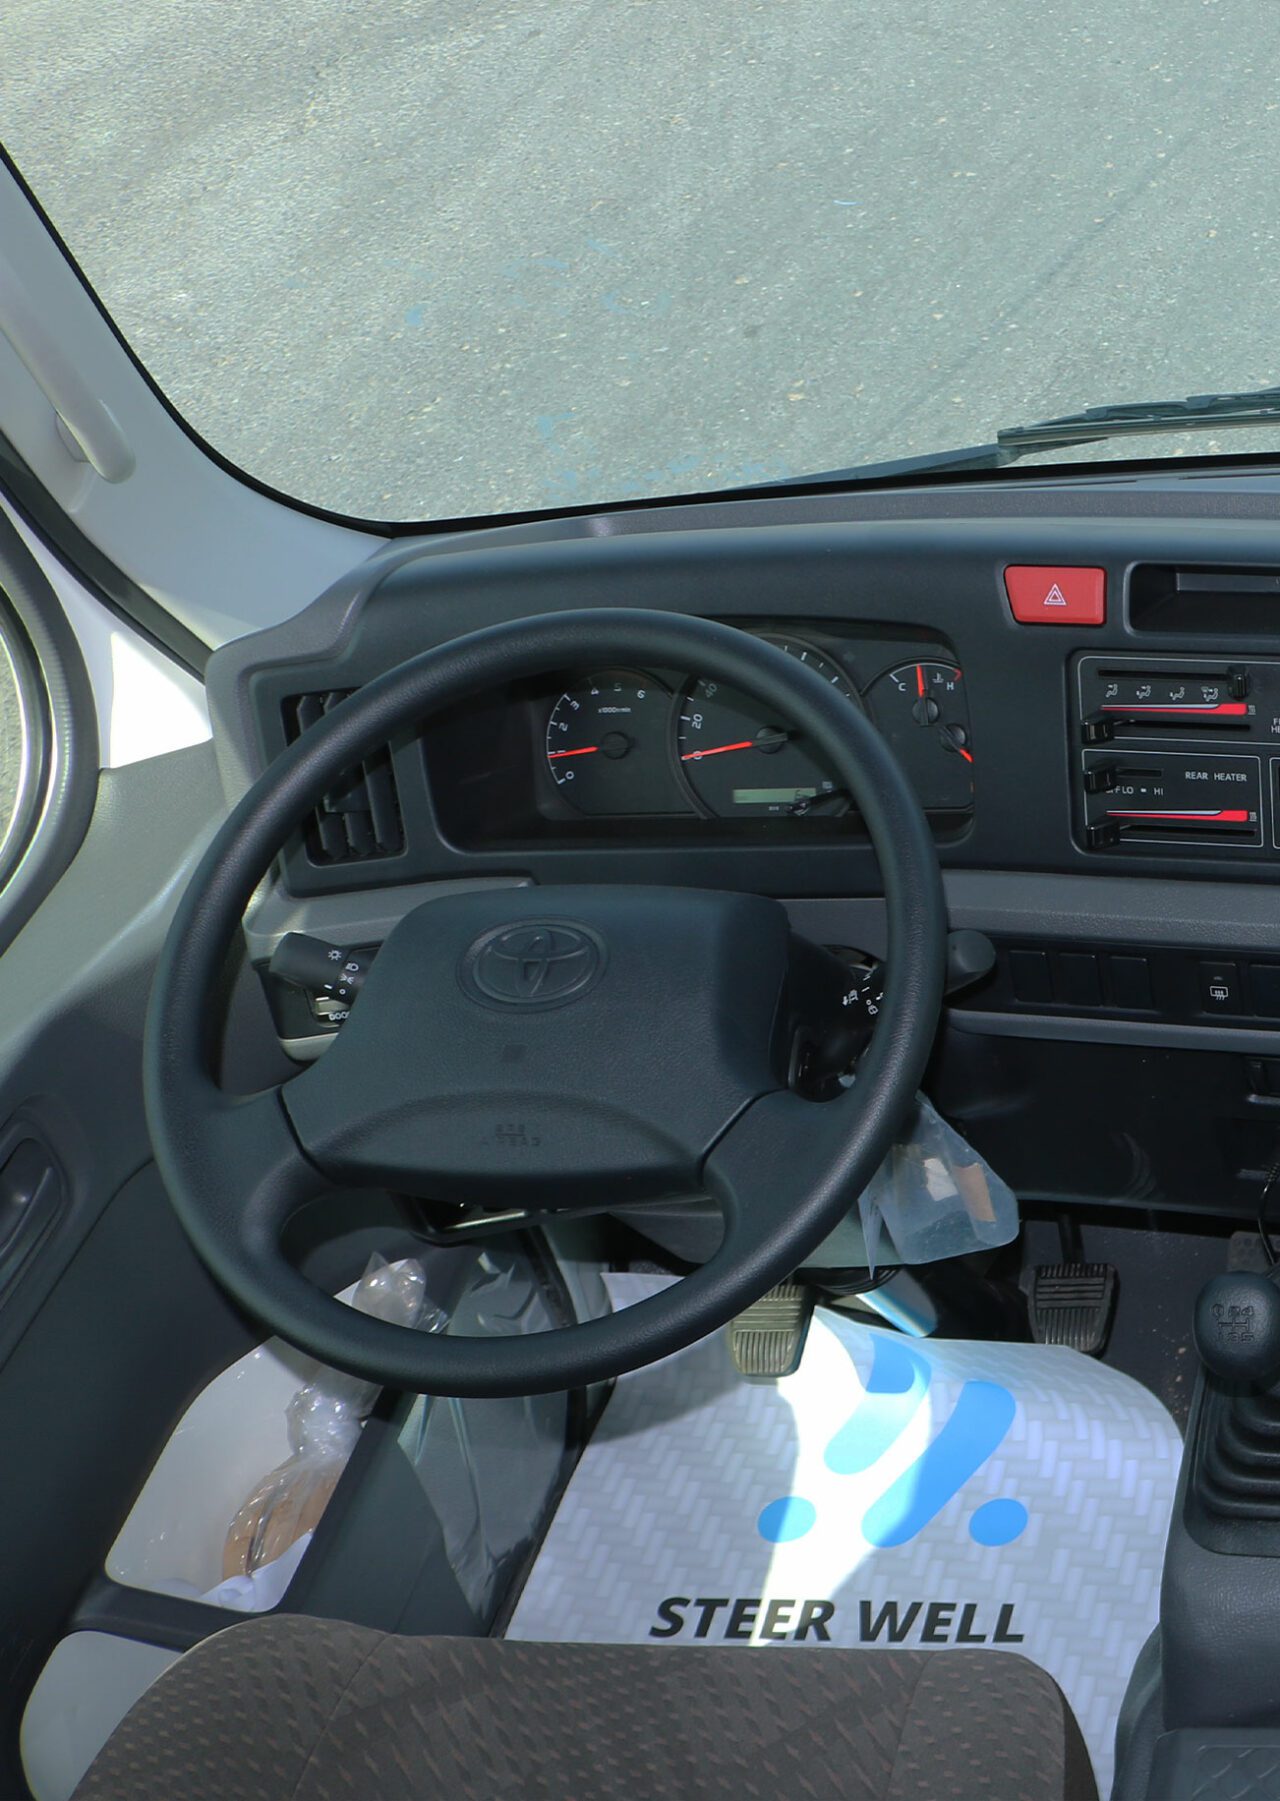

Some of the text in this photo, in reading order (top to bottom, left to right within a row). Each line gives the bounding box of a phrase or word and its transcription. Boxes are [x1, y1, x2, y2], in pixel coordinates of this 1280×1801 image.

[946, 682, 954, 690] H
[637, 690, 645, 699] 6
[570, 700, 580, 710] 3
[691, 713, 703, 730] 20
[558, 722, 568, 732] 2
[565, 770, 574, 780] 0
[1185, 771, 1247, 782] REAR HEATER
[1122, 785, 1134, 794] LO
[1153, 787, 1164, 796] HI
[649, 1596, 1025, 1643] STEER WELL
